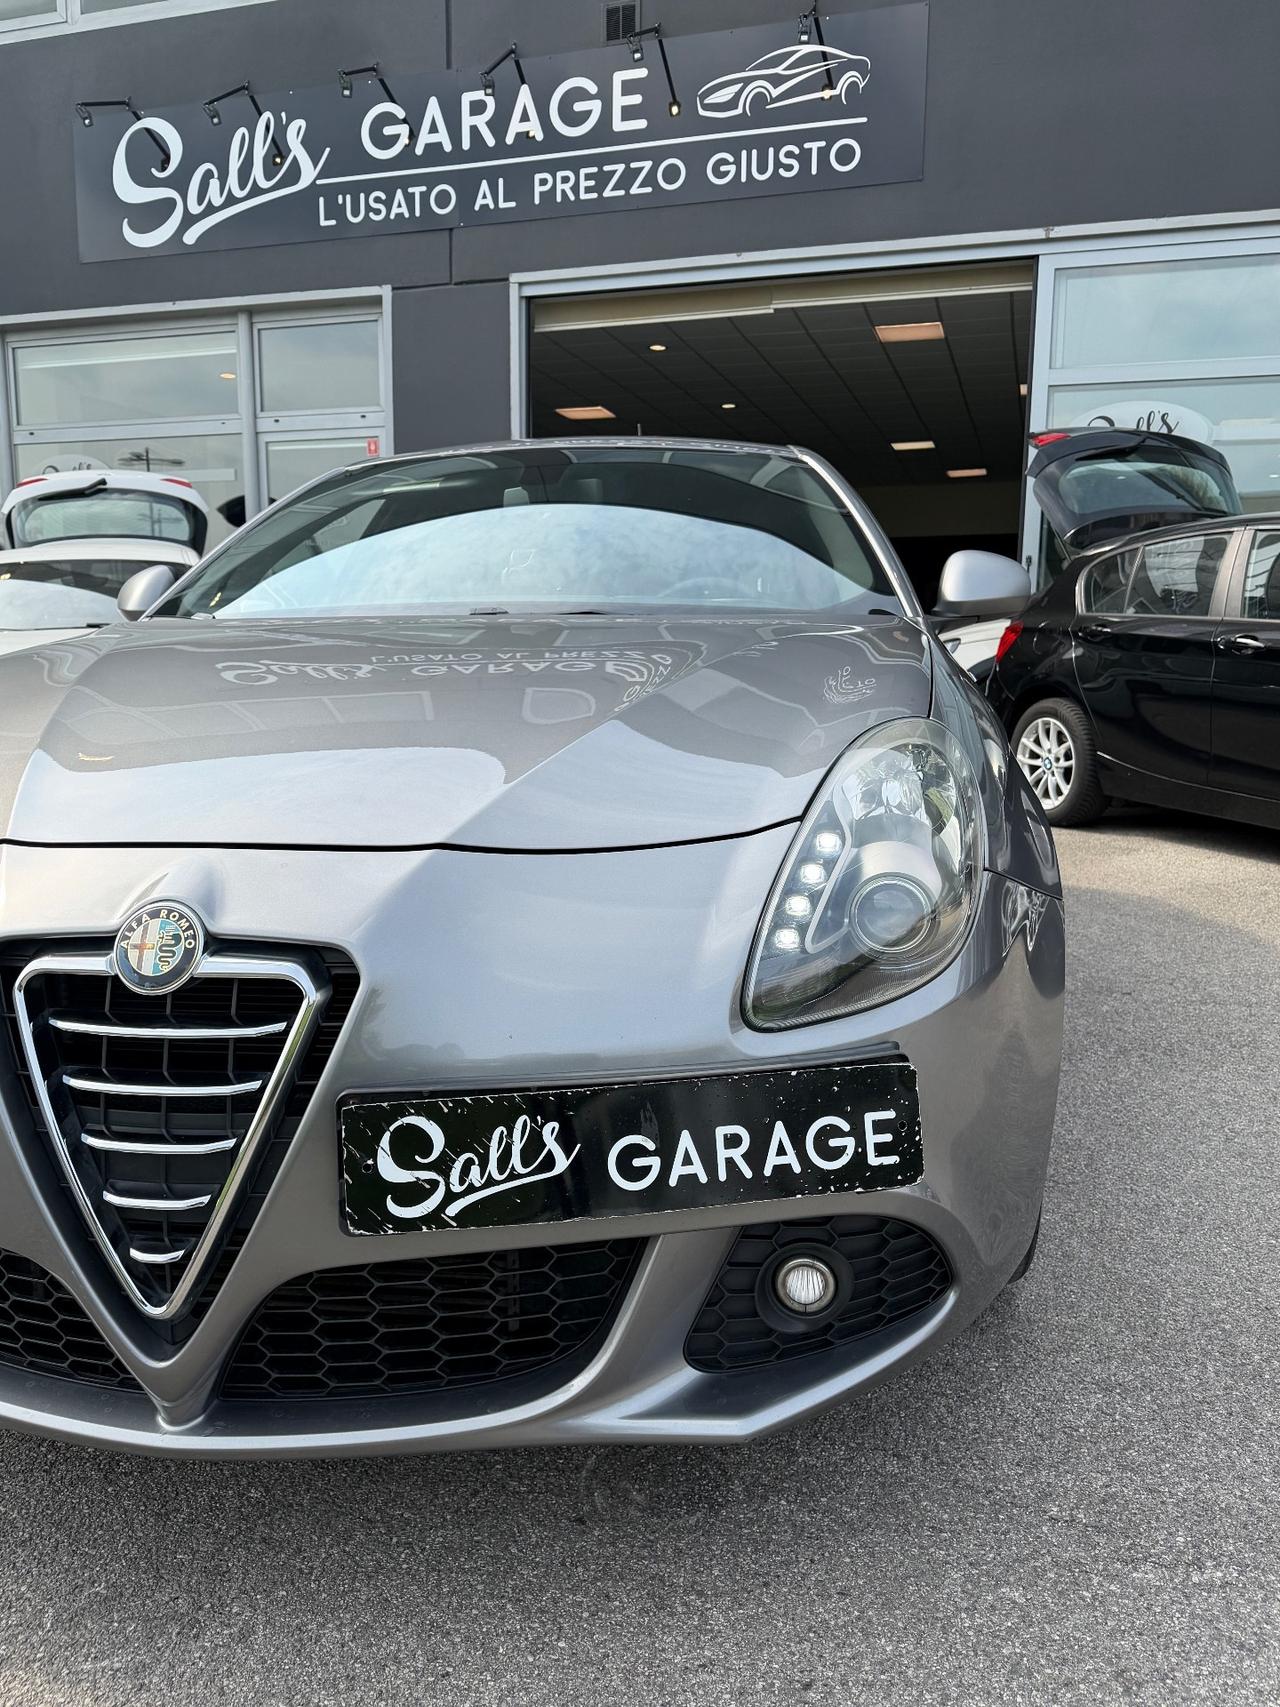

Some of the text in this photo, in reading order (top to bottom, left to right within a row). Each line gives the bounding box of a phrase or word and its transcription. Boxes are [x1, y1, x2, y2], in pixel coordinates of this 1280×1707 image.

[112, 67, 649, 248] Sall's GARAGE
[319, 138, 861, 226] L'USATO AL PREZZO GIUSTO
[120, 909, 195, 949] ALFA ROMEO
[376, 1109, 900, 1219] Sall's GARAGE
